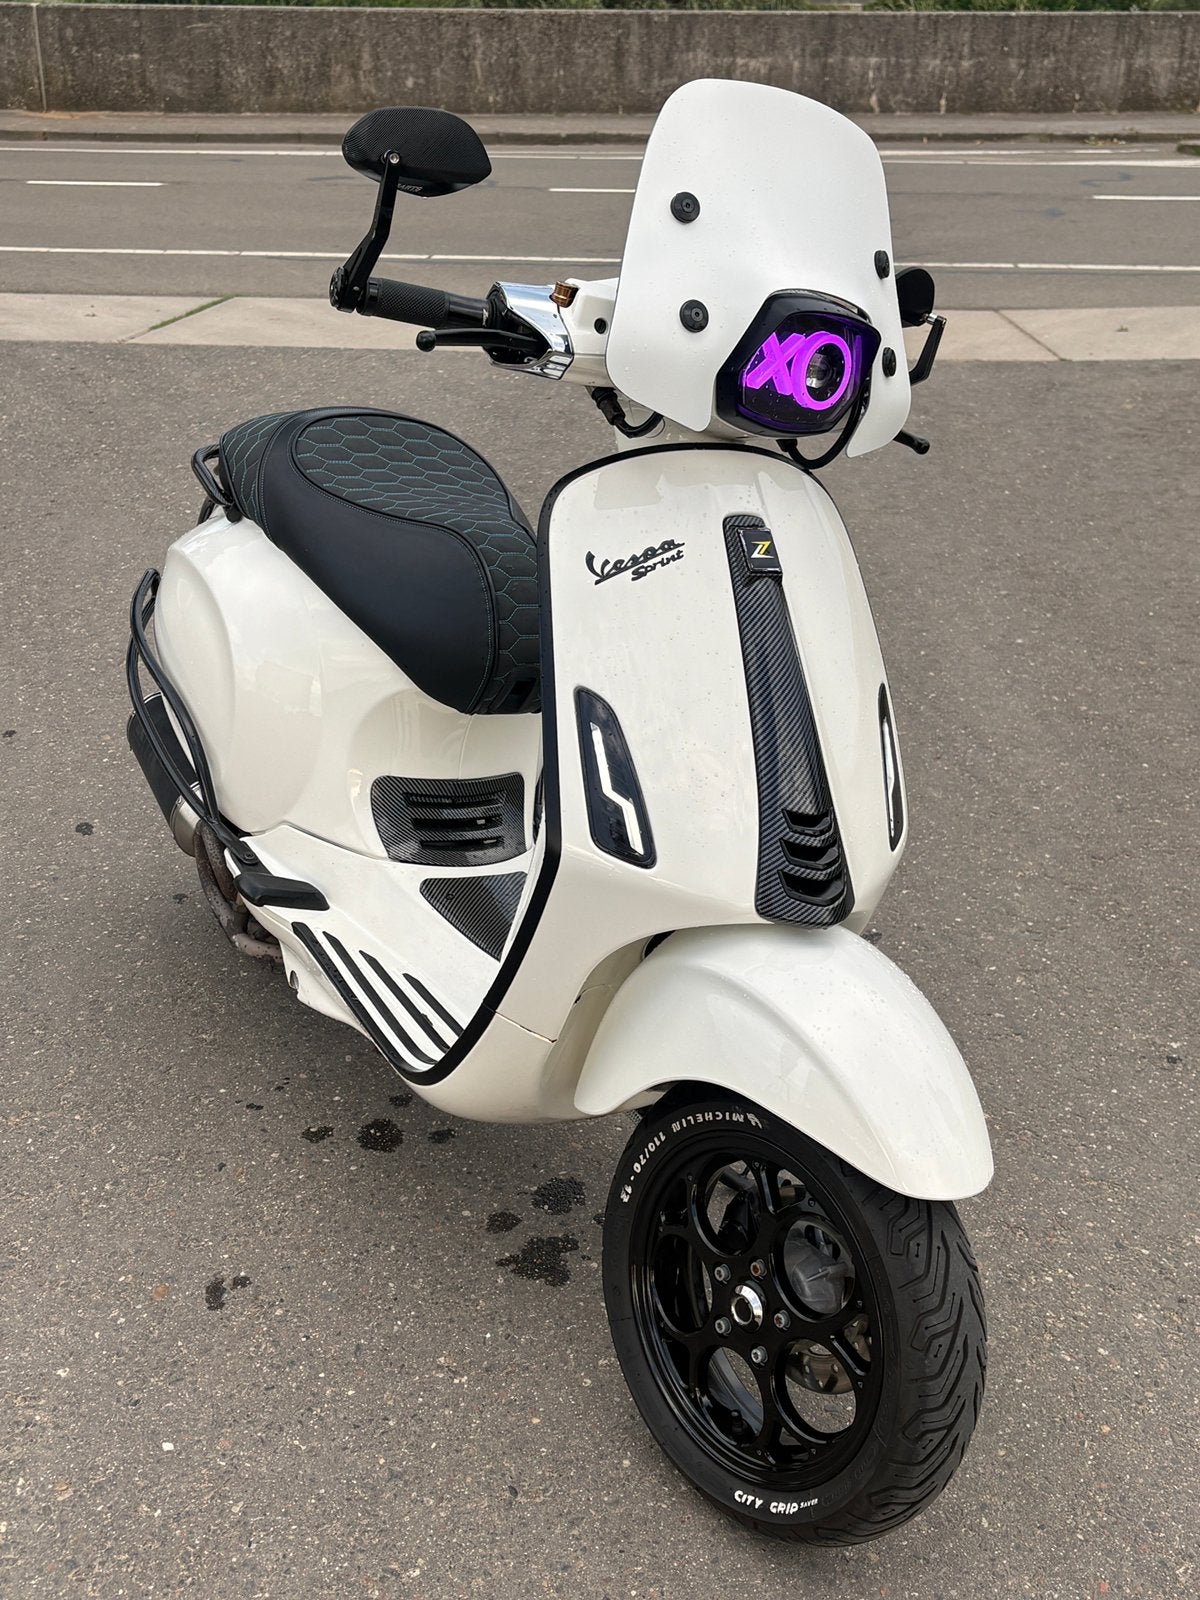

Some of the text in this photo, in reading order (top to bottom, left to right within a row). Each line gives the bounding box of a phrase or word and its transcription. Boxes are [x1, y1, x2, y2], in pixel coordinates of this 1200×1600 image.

[747, 331, 852, 411] XO
[585, 539, 685, 585] Vespa
[631, 549, 684, 581] Sprint
[672, 1111, 744, 1133] MICHELIN
[734, 1490, 819, 1515] CITY GRIP SAVER
